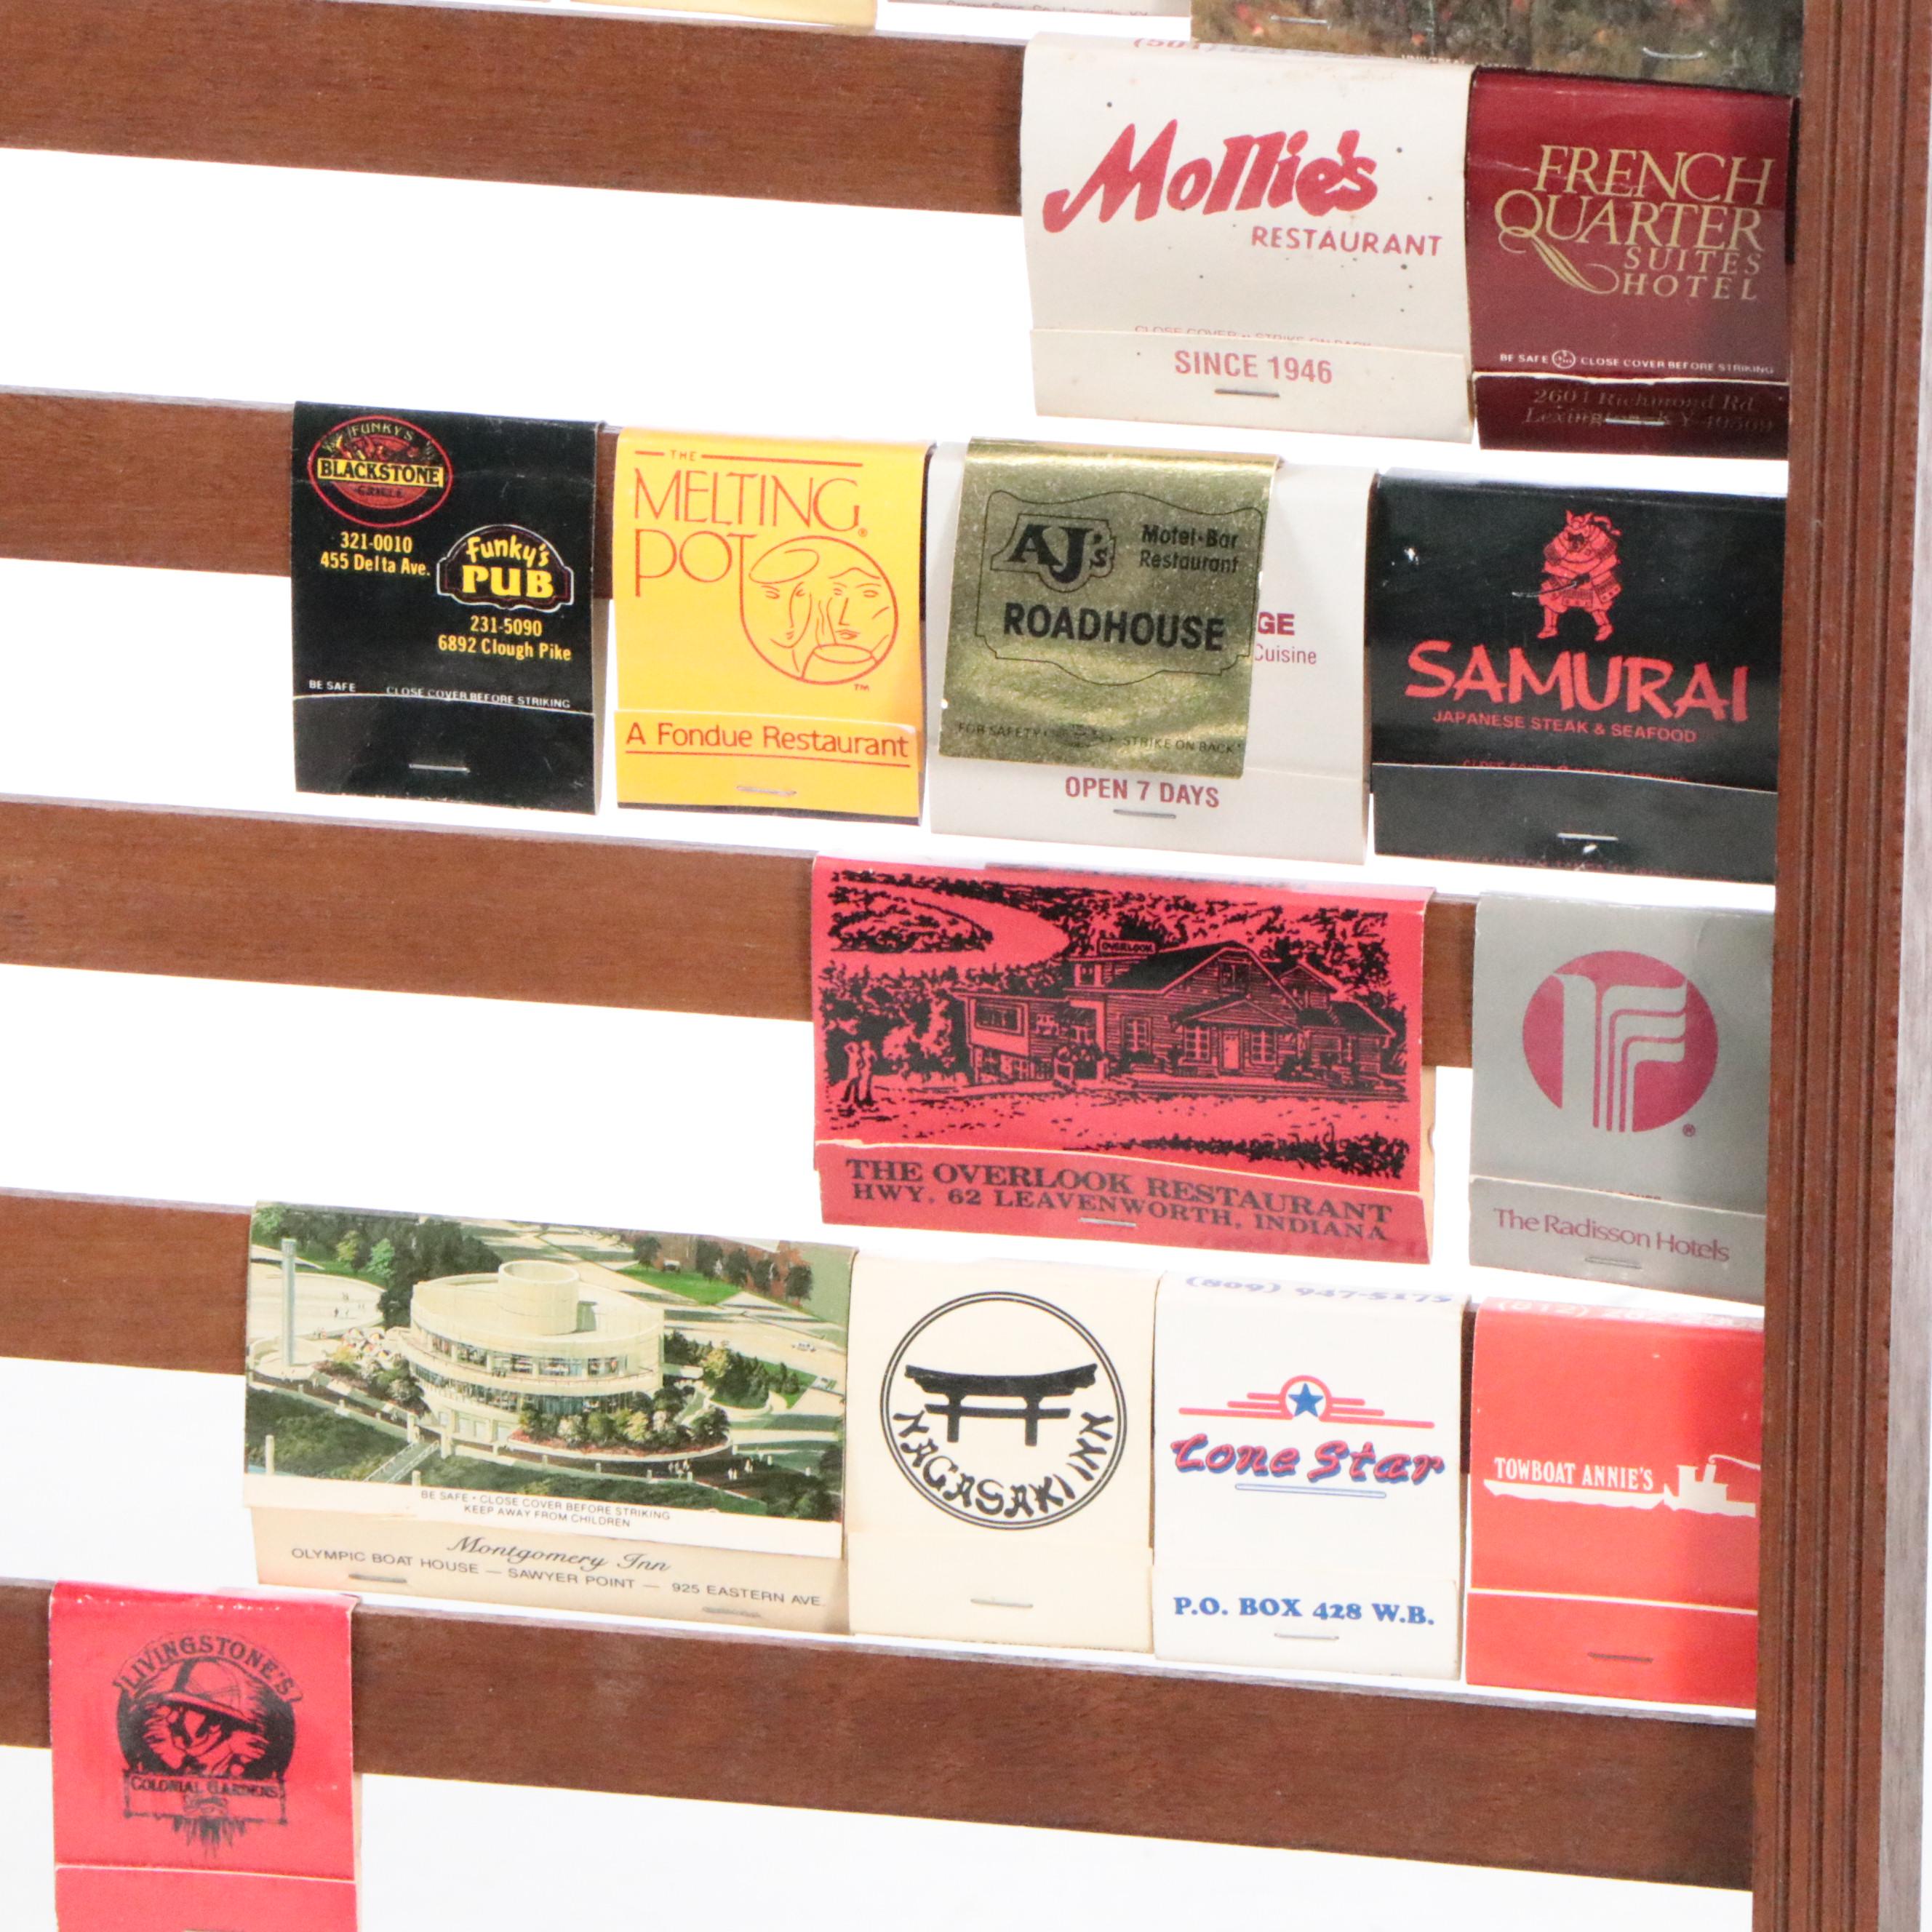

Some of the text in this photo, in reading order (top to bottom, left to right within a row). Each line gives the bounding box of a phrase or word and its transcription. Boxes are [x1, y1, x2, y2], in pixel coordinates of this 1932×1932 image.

[1042, 119, 1378, 233] Mollie's
[1532, 145, 1775, 206] FRENCH
[1494, 189, 1765, 256] QUARTER
[1251, 225, 1442, 256] RESTAURANT
[1624, 247, 1760, 275] SUITES
[1623, 272, 1757, 300] HOTEL
[1175, 350, 1332, 384] SINCE 1946
[1500, 354, 1774, 374] BE SAFE CLOSE COVER BEFORE STRIKING
[1534, 389, 1589, 403] 2601
[321, 460, 439, 484] BLACKSTONE
[670, 450, 696, 461] THE
[634, 468, 861, 532] MELTING
[340, 531, 412, 554] 321-0010
[466, 535, 550, 568] Funky's
[1007, 524, 1109, 583] AJ's
[320, 552, 431, 577] 455 Delta Ave.
[634, 528, 757, 598] POT
[1140, 549, 1239, 573] Restaurant
[461, 564, 554, 599] PUB
[470, 615, 542, 637] 231-5090
[1003, 602, 1225, 651] ROADHOUSE
[1257, 611, 1295, 636] GE
[438, 635, 572, 661] 6892 Clough Pike
[308, 679, 571, 708] BE SAFE CLOSE COVER BEFORE STRIKING
[1405, 639, 1749, 723] SAMURAI
[626, 721, 909, 758] A Fondue Restaurant
[1433, 708, 1697, 743] JAPANESE STEAK & SEAFOOD
[1122, 735, 1171, 749] STRIKE
[1175, 739, 1195, 751] ON
[1065, 775, 1219, 808] OPEN 7 DAYS
[846, 1158, 1393, 1224] THE OVERLOOK RESTAURANT
[852, 1183, 1388, 1242] HWY. 62 LEAVENWORTH, INDIANA
[1494, 1207, 1730, 1263] The Radisson Hotels
[1186, 1275, 1281, 1294] (809)
[893, 1410, 1115, 1518] NAGASAKI INN
[1170, 1433, 1445, 1485] Lone Star
[1493, 1457, 1653, 1491] TOWBOAT ANNIE'S
[420, 1489, 671, 1520] BE SAFE CLOSE COVER BEFORE STRIKING
[463, 1504, 631, 1528] KEEP AWAY FROM CHILDREN
[446, 1535, 671, 1573] Montgomery Inn
[291, 1547, 366, 1562] OLYMPIC
[372, 1553, 413, 1567] BOAT
[420, 1558, 479, 1575] HOUSE
[508, 1568, 578, 1584] SAWYER
[586, 1575, 635, 1589] POINT
[671, 1581, 700, 1594] 925
[707, 1584, 786, 1603] EASTERN
[1173, 1597, 1435, 1626] P.O. BOX 428 W.B.
[124, 1635, 294, 1696] LIVINGSTONE'S
